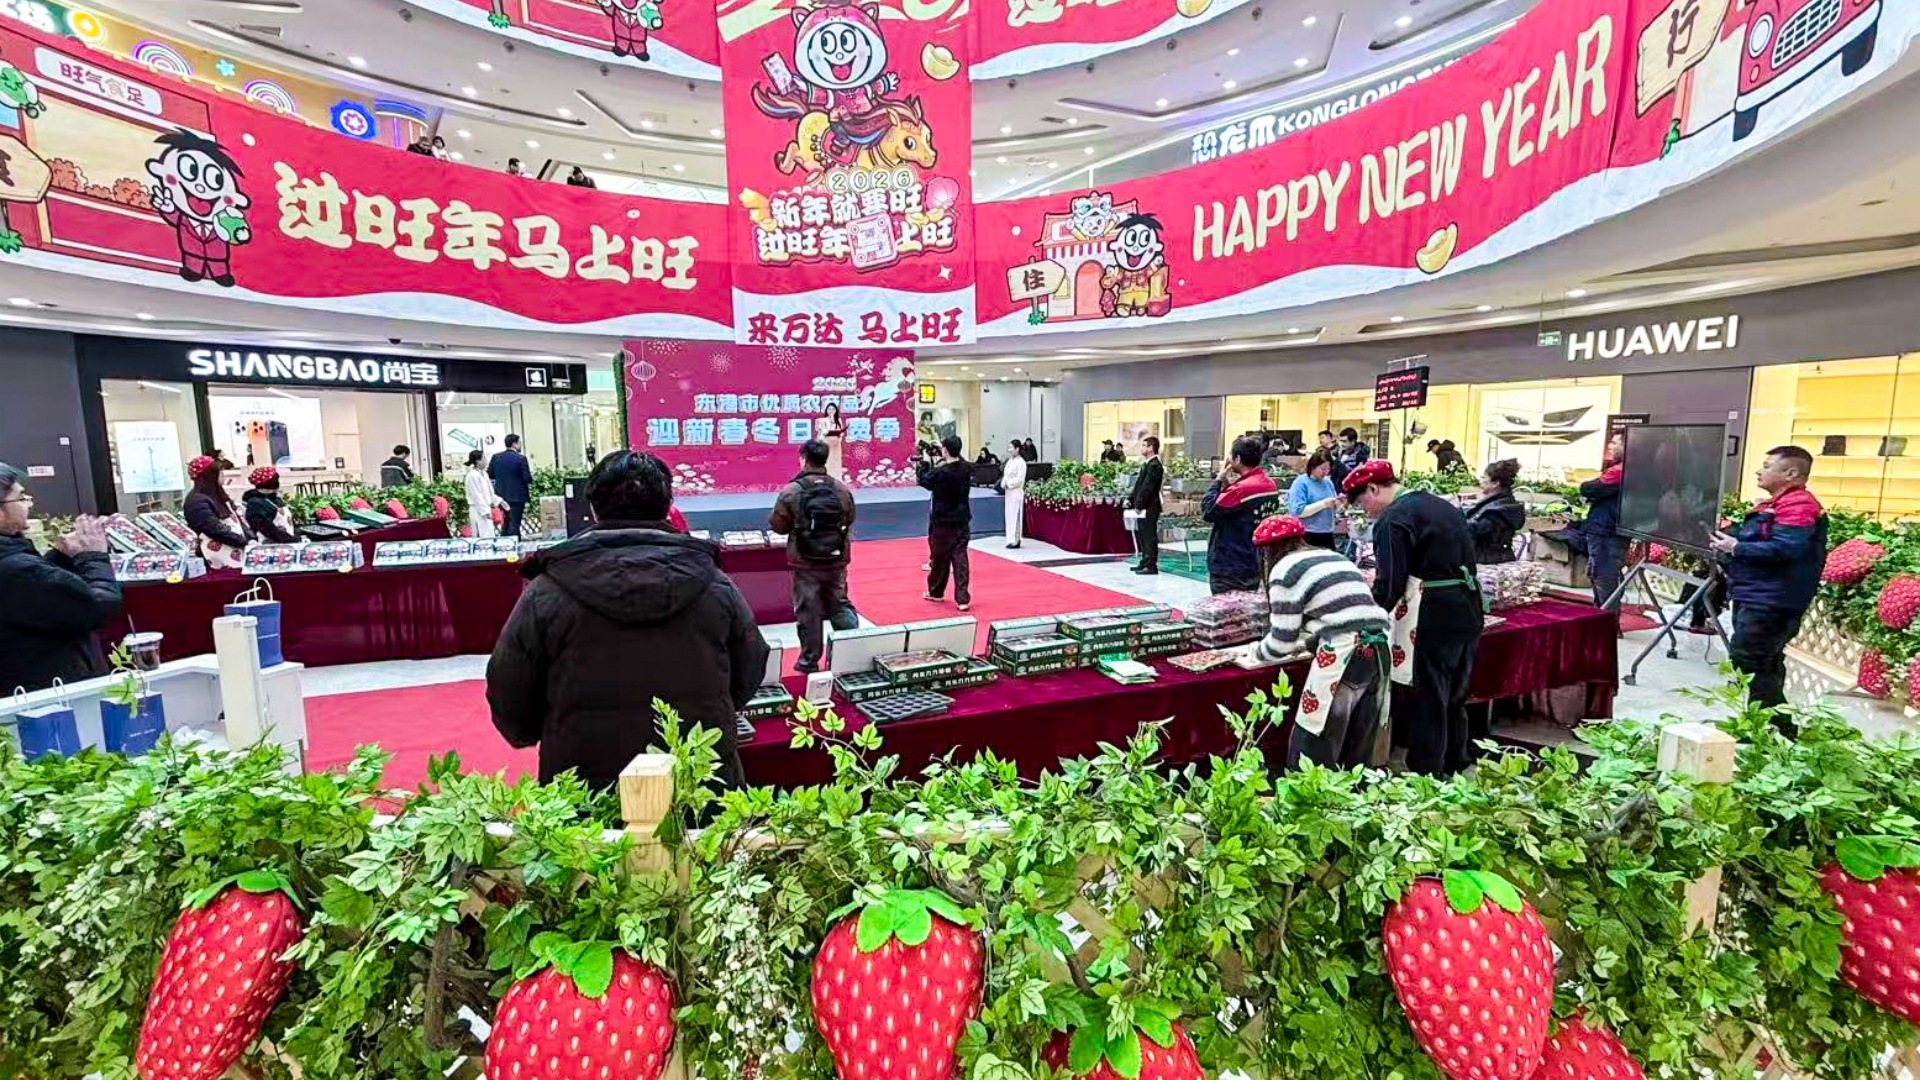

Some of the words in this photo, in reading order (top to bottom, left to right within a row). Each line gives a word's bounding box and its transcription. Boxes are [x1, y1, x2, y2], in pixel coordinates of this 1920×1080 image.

[1192, 161, 1351, 262] HAPPY
[1358, 113, 1468, 225] NEW
[1480, 14, 1613, 179] YEAR
[829, 167, 914, 193] 2026
[772, 184, 923, 228] 新年就要旺
[273, 161, 699, 291] 过旺年马上旺
[1023, 269, 1045, 292] 住
[748, 312, 844, 344] 来万达
[858, 308, 963, 344] 马上旺
[1567, 315, 1739, 361] HUAWEI
[188, 349, 380, 383] SHANGBAO
[382, 361, 440, 385] 尚宝
[694, 393, 859, 413] 东港市优质农产品
[647, 417, 900, 446] 迎新春冬日费季
